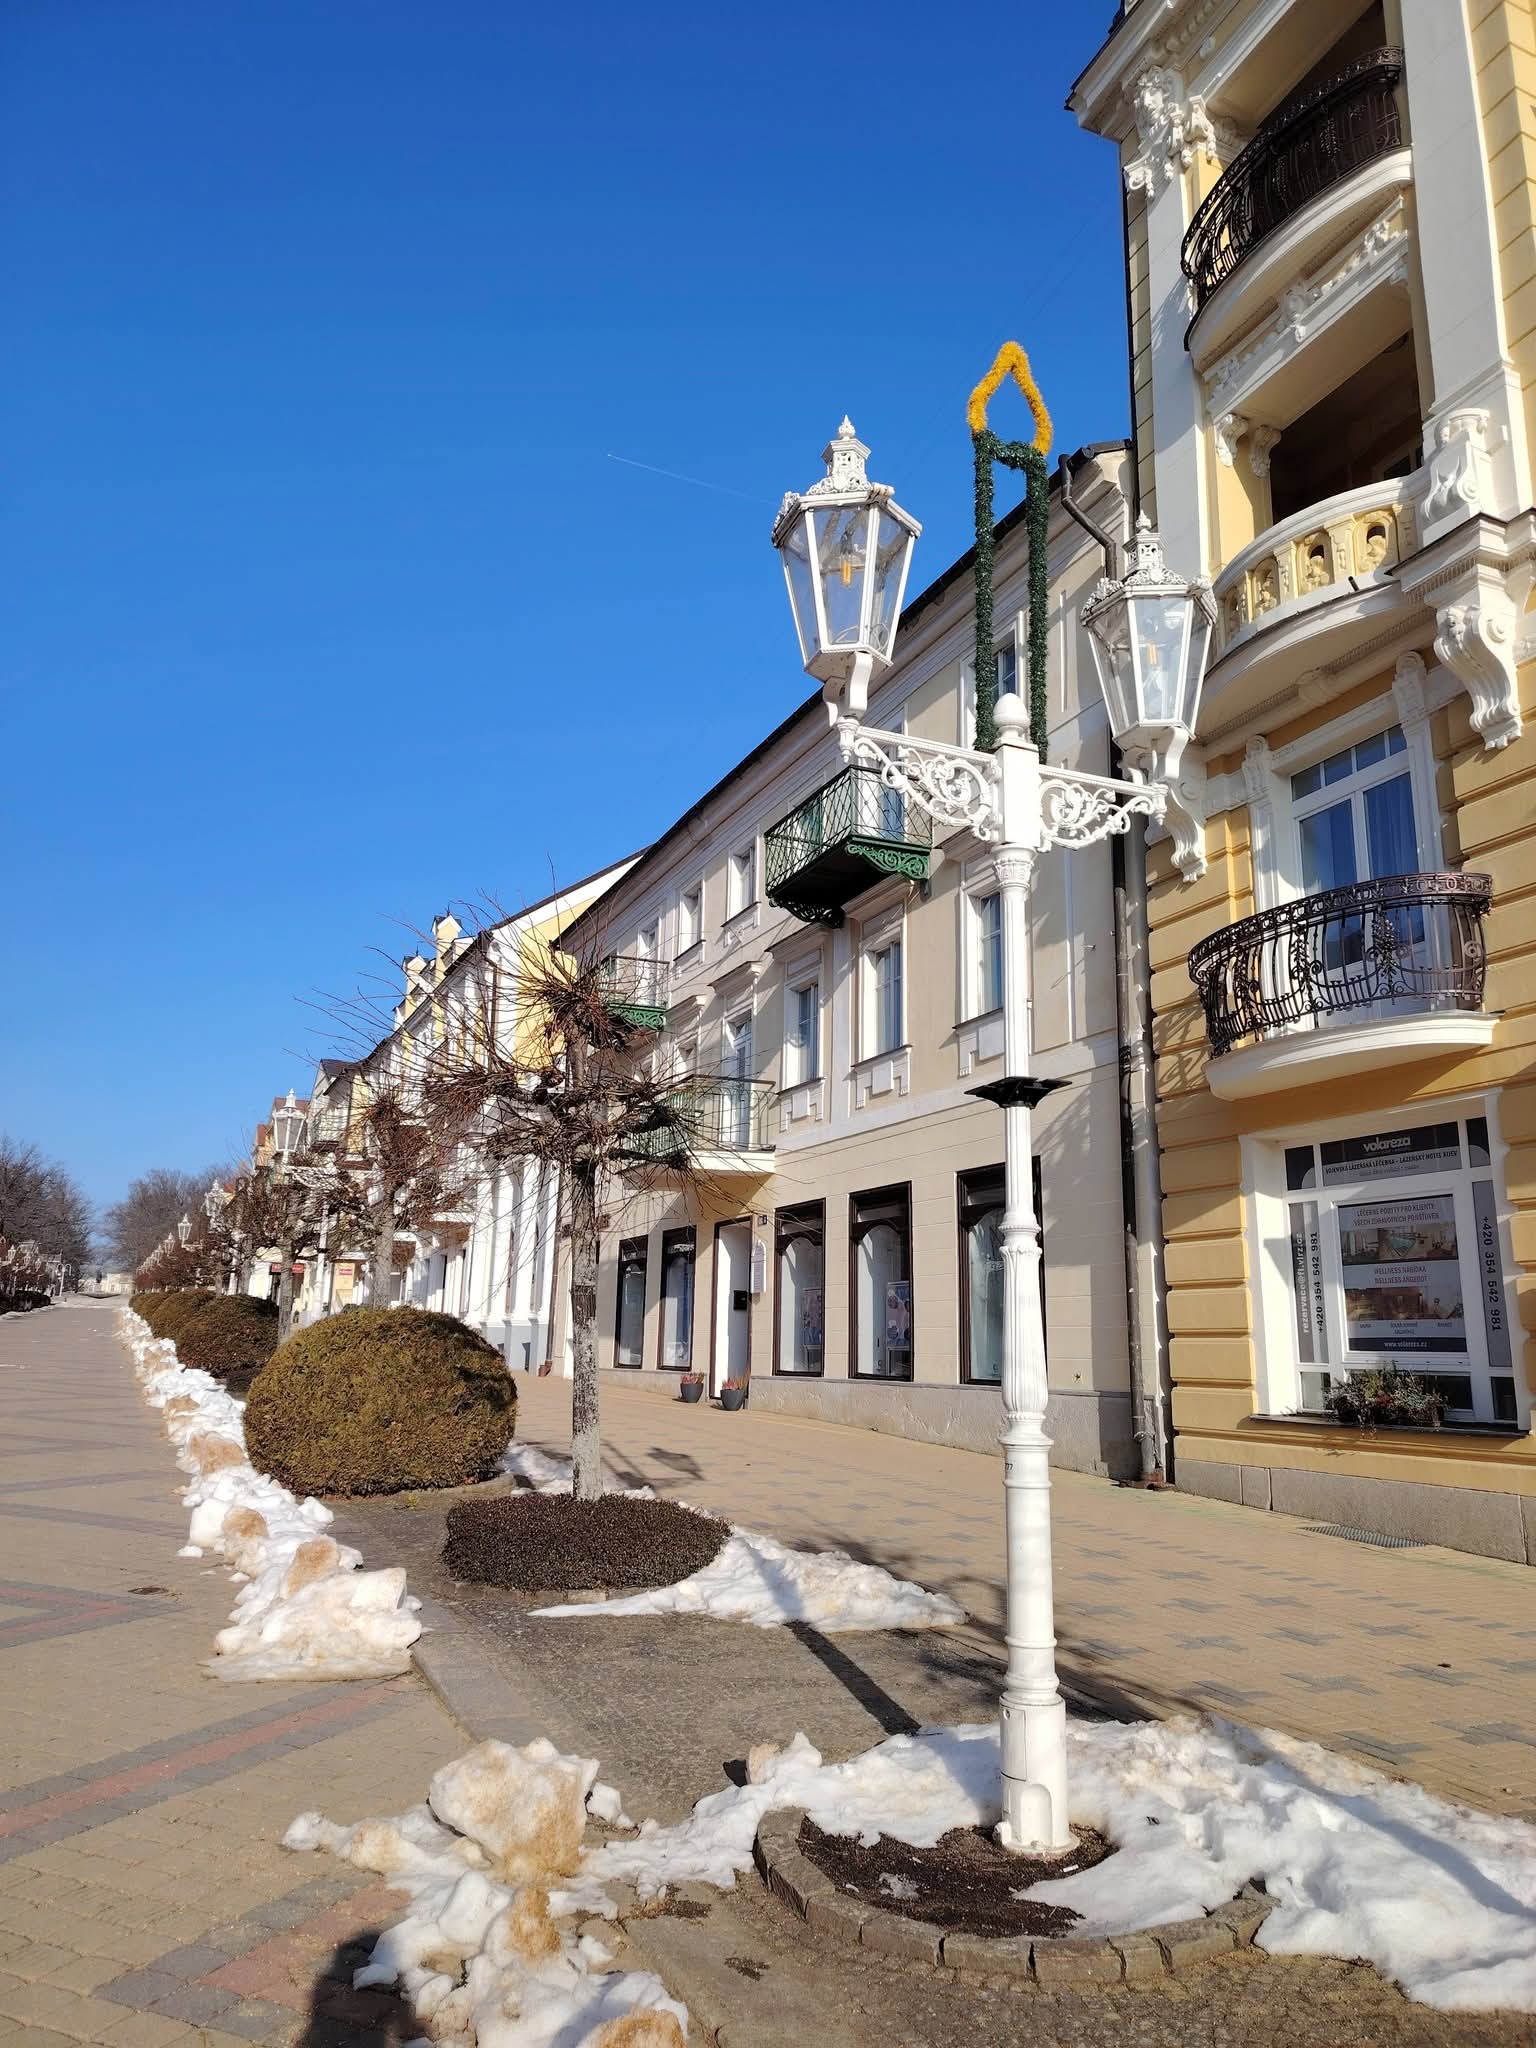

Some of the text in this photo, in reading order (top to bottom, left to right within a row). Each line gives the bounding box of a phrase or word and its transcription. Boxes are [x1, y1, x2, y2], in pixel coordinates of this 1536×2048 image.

[1363, 1135, 1411, 1152] volareza
[1310, 1232, 1324, 1333] +420 354 542 981
[1483, 1216, 1502, 1332] +420 354 542 981
